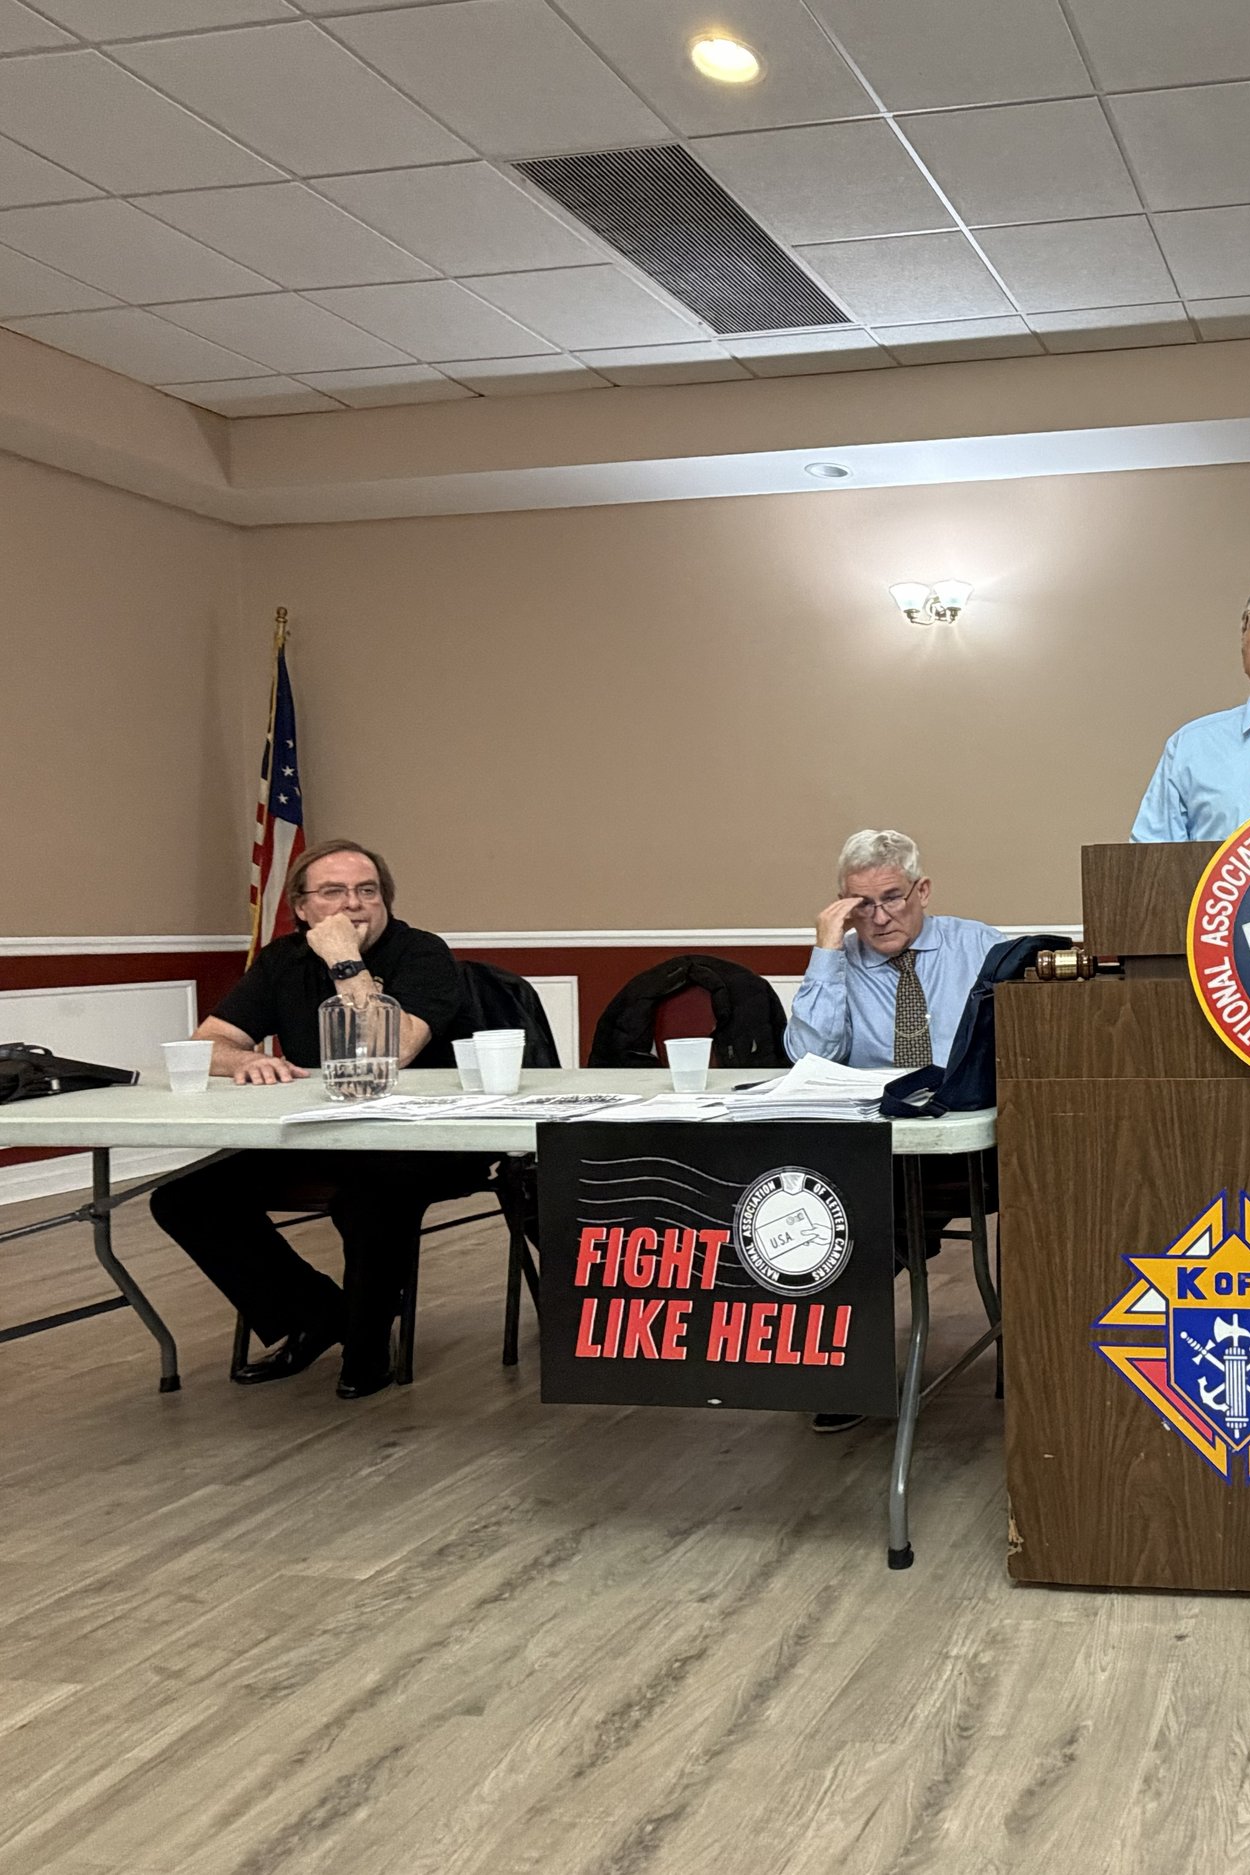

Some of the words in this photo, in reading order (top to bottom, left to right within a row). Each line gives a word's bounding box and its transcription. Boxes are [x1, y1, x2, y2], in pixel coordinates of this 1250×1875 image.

[742, 1180, 776, 1237] ASSOCIATION
[813, 1183, 827, 1196] OF
[825, 1196, 845, 1231] LETTER
[574, 1227, 730, 1290] FIGHT
[745, 1242, 780, 1281] NATIONAL
[812, 1238, 845, 1281] CARRIERS
[1176, 1266, 1208, 1300] K
[575, 1298, 693, 1360] LIKE
[706, 1301, 852, 1366] HELL!
